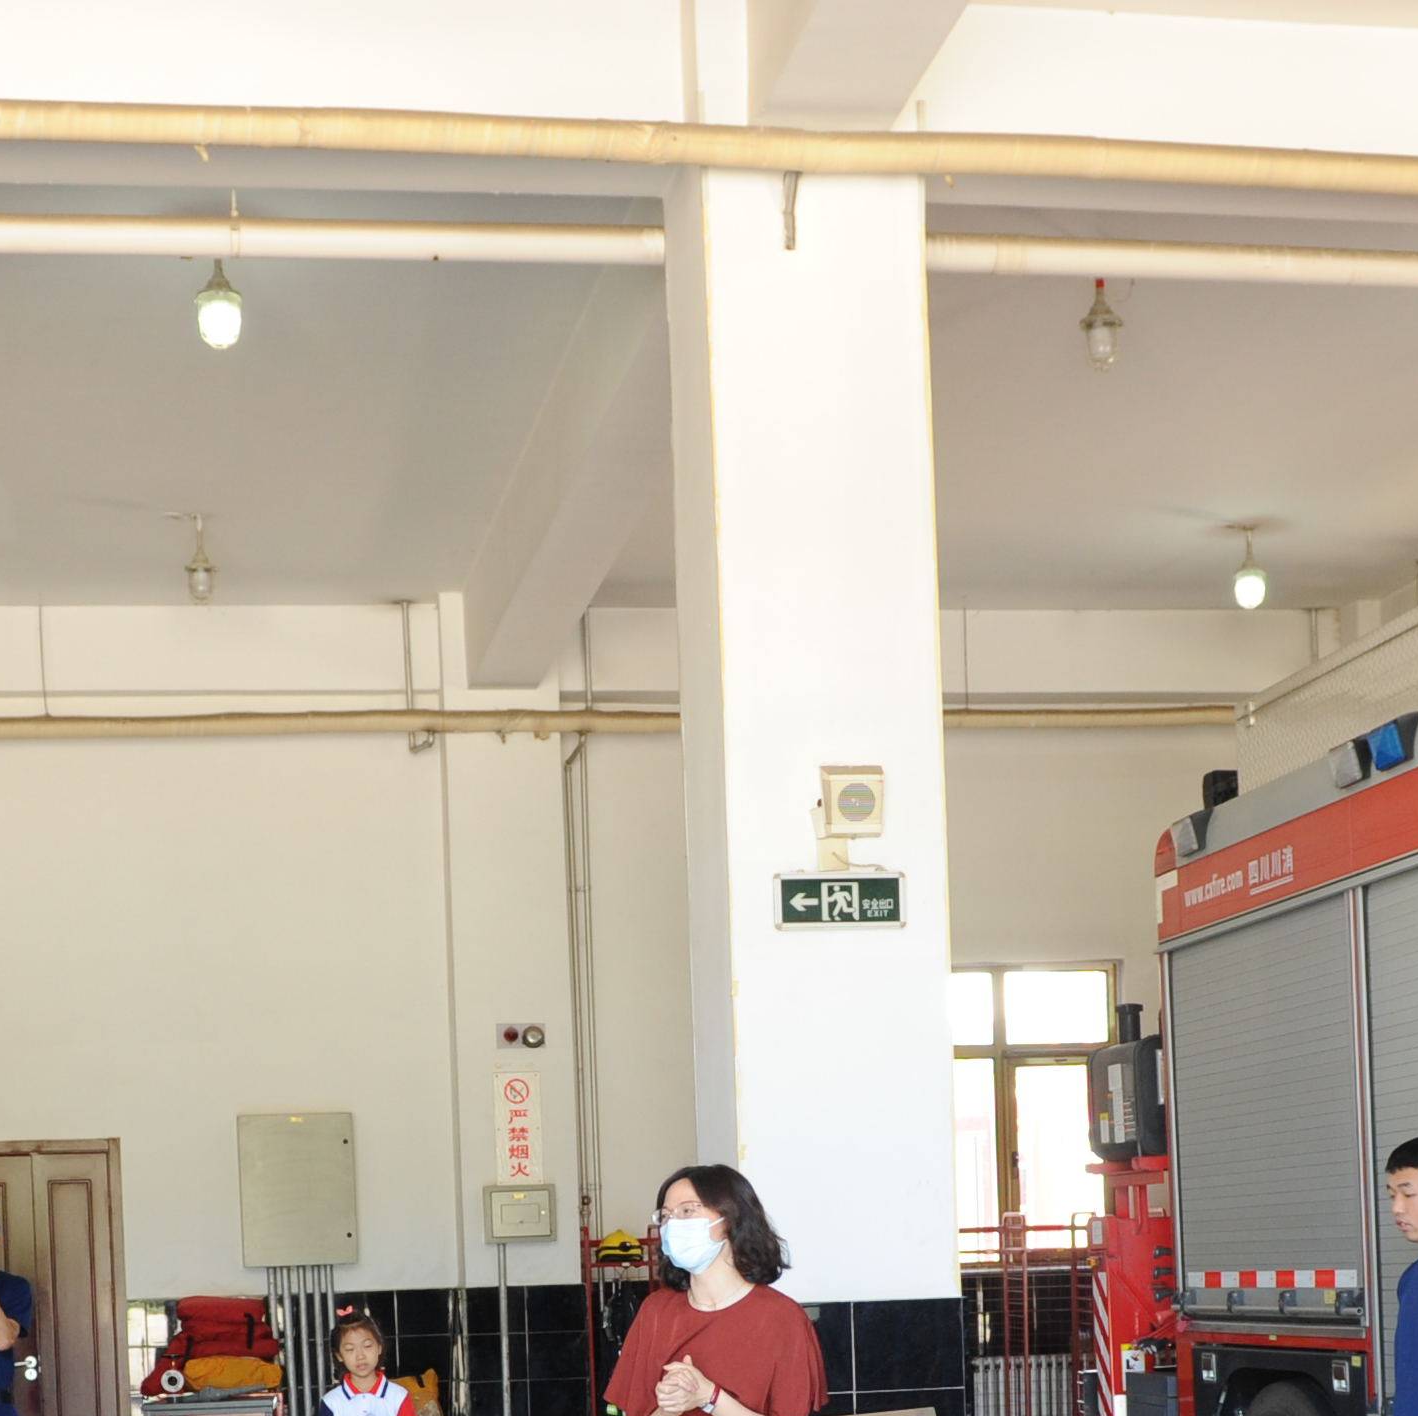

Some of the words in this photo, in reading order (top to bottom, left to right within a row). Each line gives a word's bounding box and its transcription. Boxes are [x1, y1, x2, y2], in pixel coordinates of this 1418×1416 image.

[1248, 845, 1293, 885] 四川川消
[861, 898, 894, 910] 安全出口
[867, 909, 889, 917] EXIT
[508, 1109, 530, 1177] 严禁烟火
